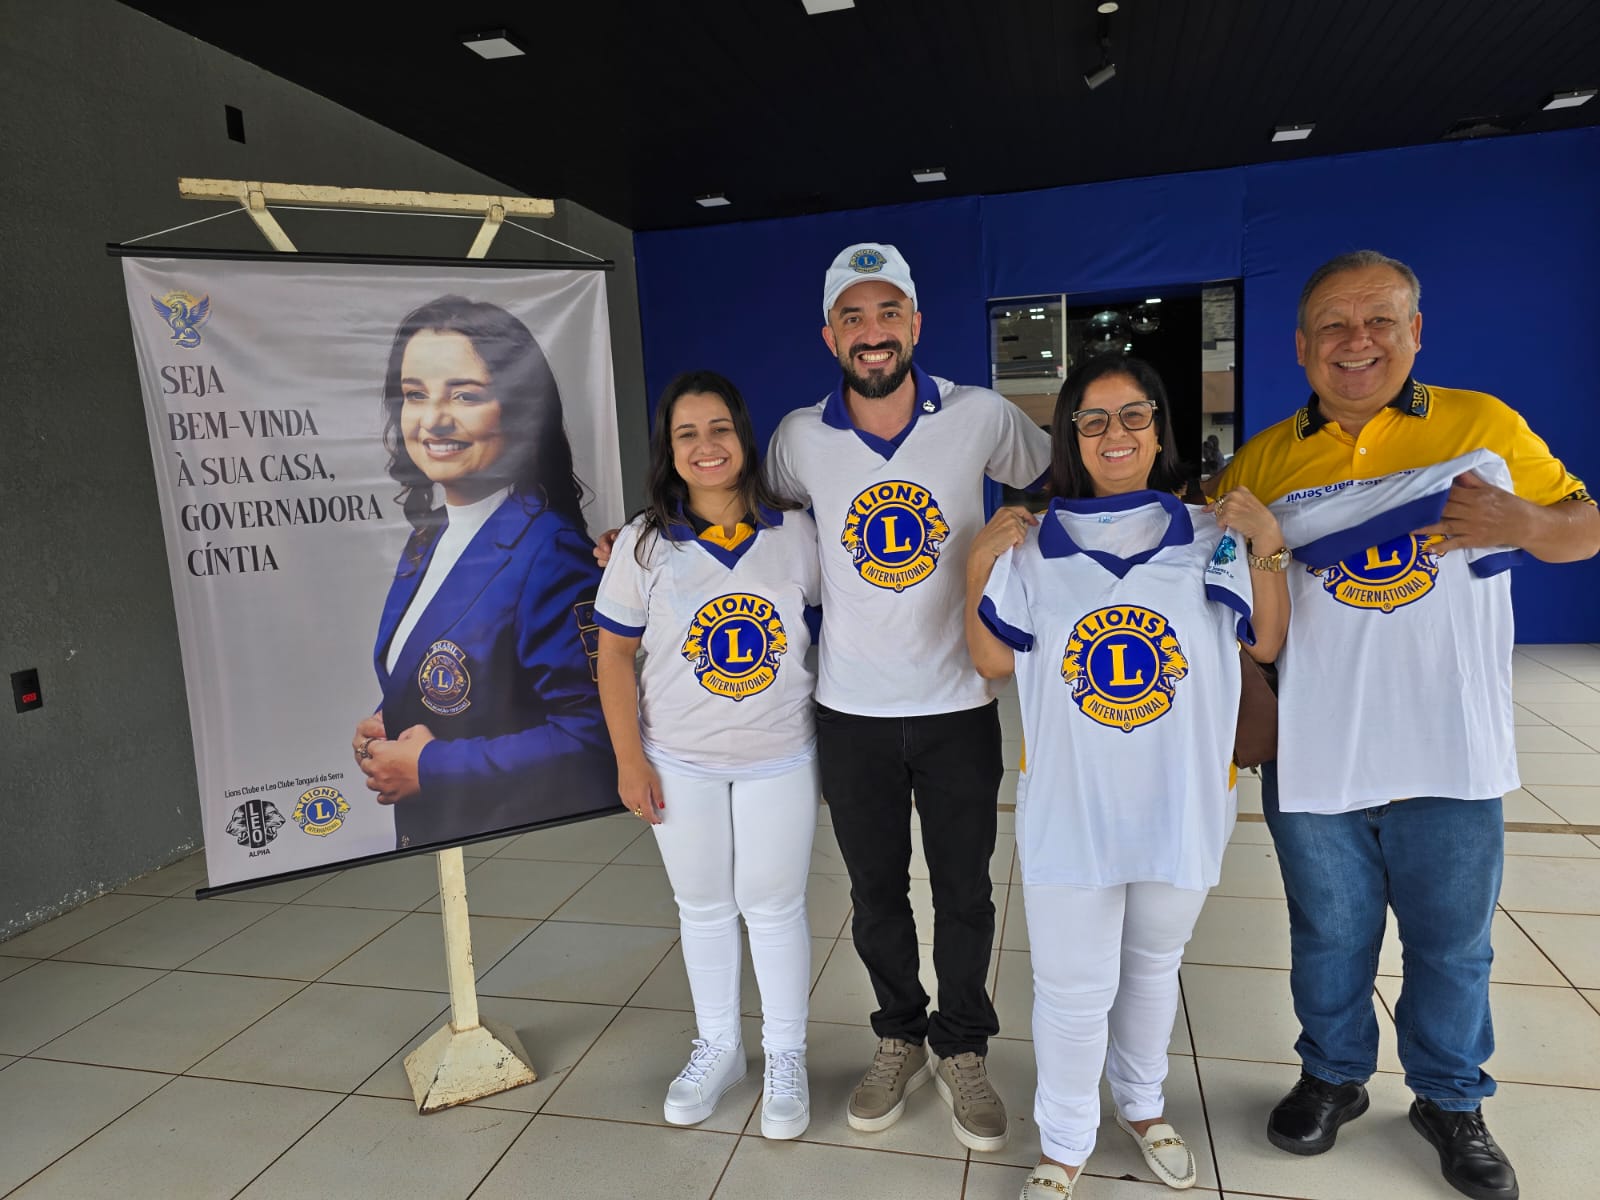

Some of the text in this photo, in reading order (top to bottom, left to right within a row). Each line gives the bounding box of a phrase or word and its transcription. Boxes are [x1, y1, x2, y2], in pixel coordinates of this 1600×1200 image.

[864, 257, 873, 266] L
[160, 365, 224, 397] SEJA
[168, 408, 319, 441] BEM-VINDA
[175, 452, 335, 487] À SUA CASA,
[858, 485, 925, 511] LIONS
[1286, 488, 1322, 503] Servir
[1326, 480, 1354, 493] para
[181, 494, 383, 532] GOVERNADORA
[881, 516, 912, 553] L
[187, 542, 279, 577] CÍNTIA
[1364, 545, 1401, 571] L
[866, 561, 930, 583] INTERNATIONAL
[1342, 577, 1427, 602] INTERNATIONAL
[701, 598, 768, 623] LIONS
[1082, 610, 1160, 637] LIONS
[725, 628, 753, 663] L
[1108, 644, 1144, 686] L
[438, 670, 448, 688] L
[707, 672, 770, 692] INTERNATIONAL
[1088, 697, 1165, 721] INTERNATIONAL
[224, 788, 241, 798] Lions
[242, 786, 259, 796] Clube
[265, 783, 276, 791] Leo
[277, 780, 295, 789] Clube
[320, 774, 327, 782] da
[328, 772, 344, 780] Serra
[303, 789, 336, 804] LIONS
[249, 803, 263, 843] LEO
[314, 802, 330, 820] L
[249, 848, 270, 858] ALPHA
